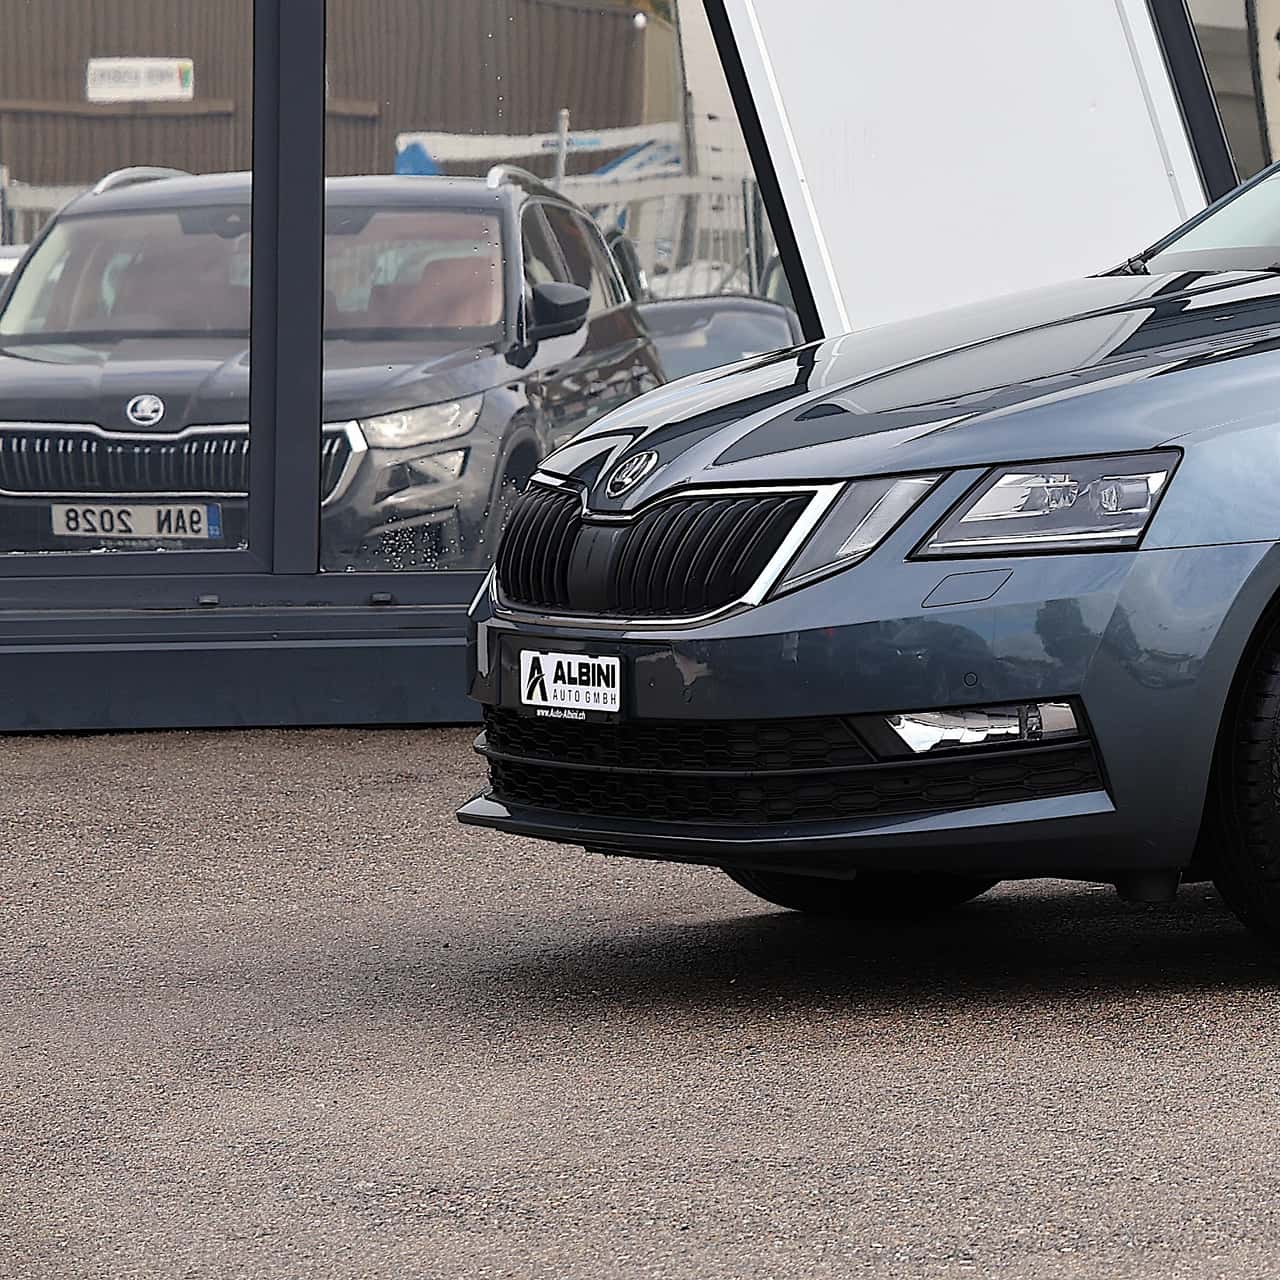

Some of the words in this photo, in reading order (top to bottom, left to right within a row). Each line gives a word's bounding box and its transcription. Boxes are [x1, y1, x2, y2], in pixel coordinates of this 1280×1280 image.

[552, 660, 616, 689] ALBINI
[552, 688, 580, 703] AUTO
[585, 691, 617, 705] GMBH
